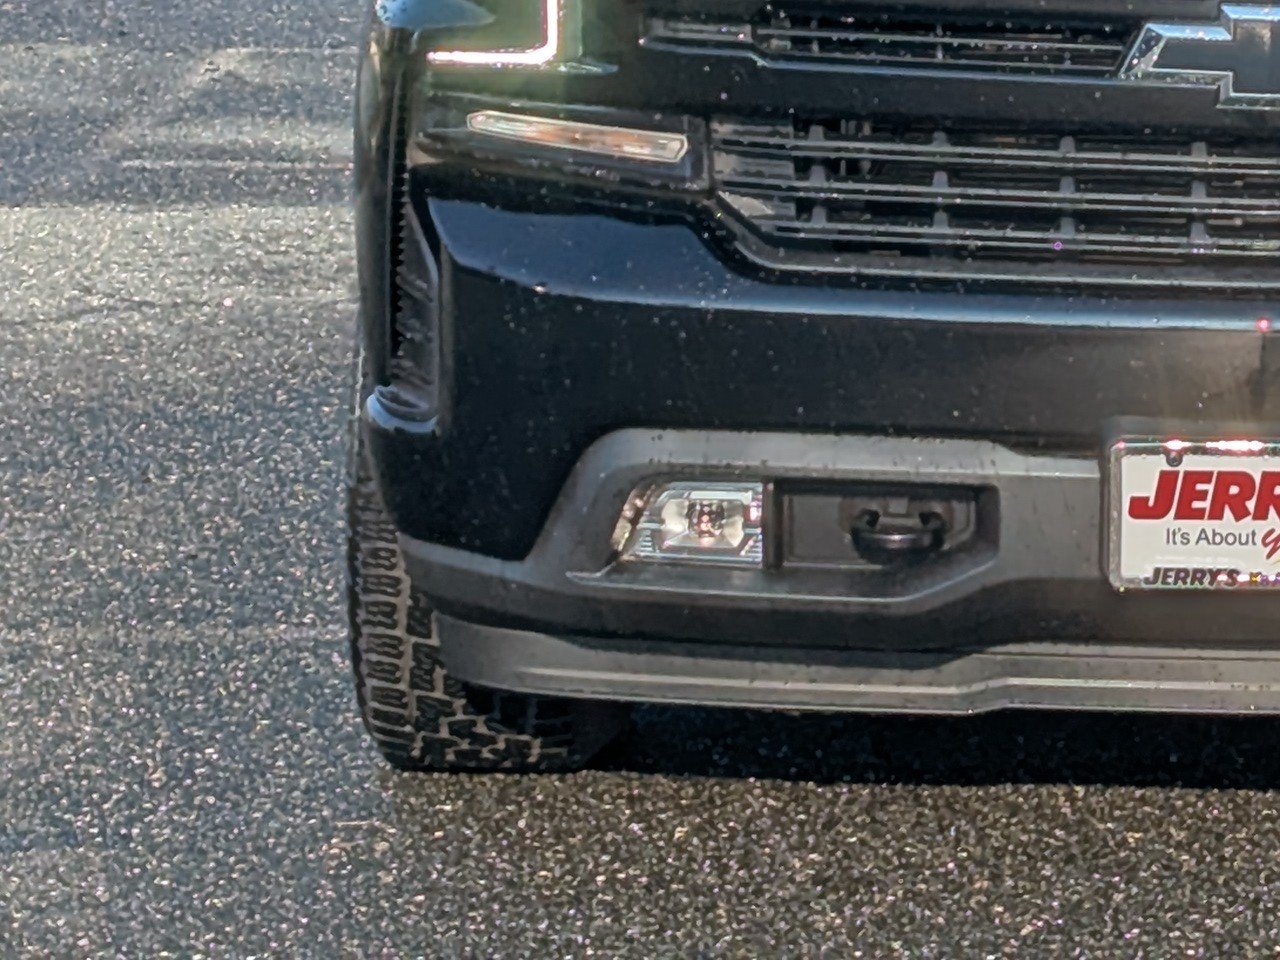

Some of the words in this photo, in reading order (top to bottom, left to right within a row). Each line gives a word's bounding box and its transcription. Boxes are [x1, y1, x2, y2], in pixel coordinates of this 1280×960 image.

[1165, 527, 1190, 546] It's
[1196, 527, 1257, 546] About
[1142, 567, 1241, 587] JERRY'S
